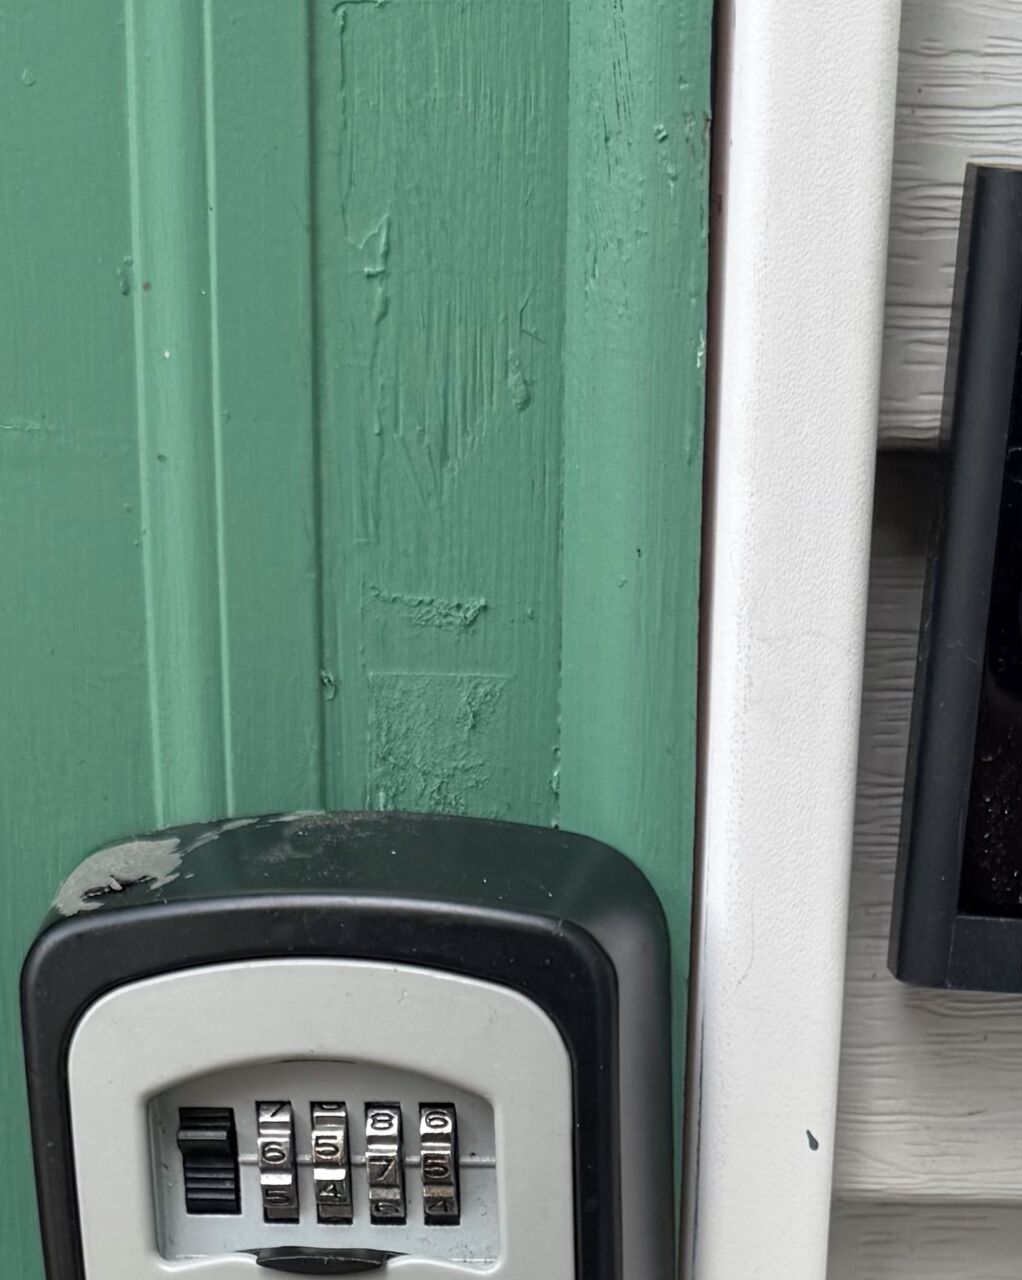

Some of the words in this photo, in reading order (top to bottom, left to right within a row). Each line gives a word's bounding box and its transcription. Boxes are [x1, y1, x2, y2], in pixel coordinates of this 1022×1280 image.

[370, 1112, 395, 1131] 8
[424, 1110, 450, 1130] 6
[261, 1141, 286, 1164] 6
[314, 1135, 340, 1160] 5
[368, 1154, 396, 1181] 7
[422, 1153, 450, 1179] 5
[264, 1187, 292, 1206] 5
[318, 1183, 344, 1204] 4
